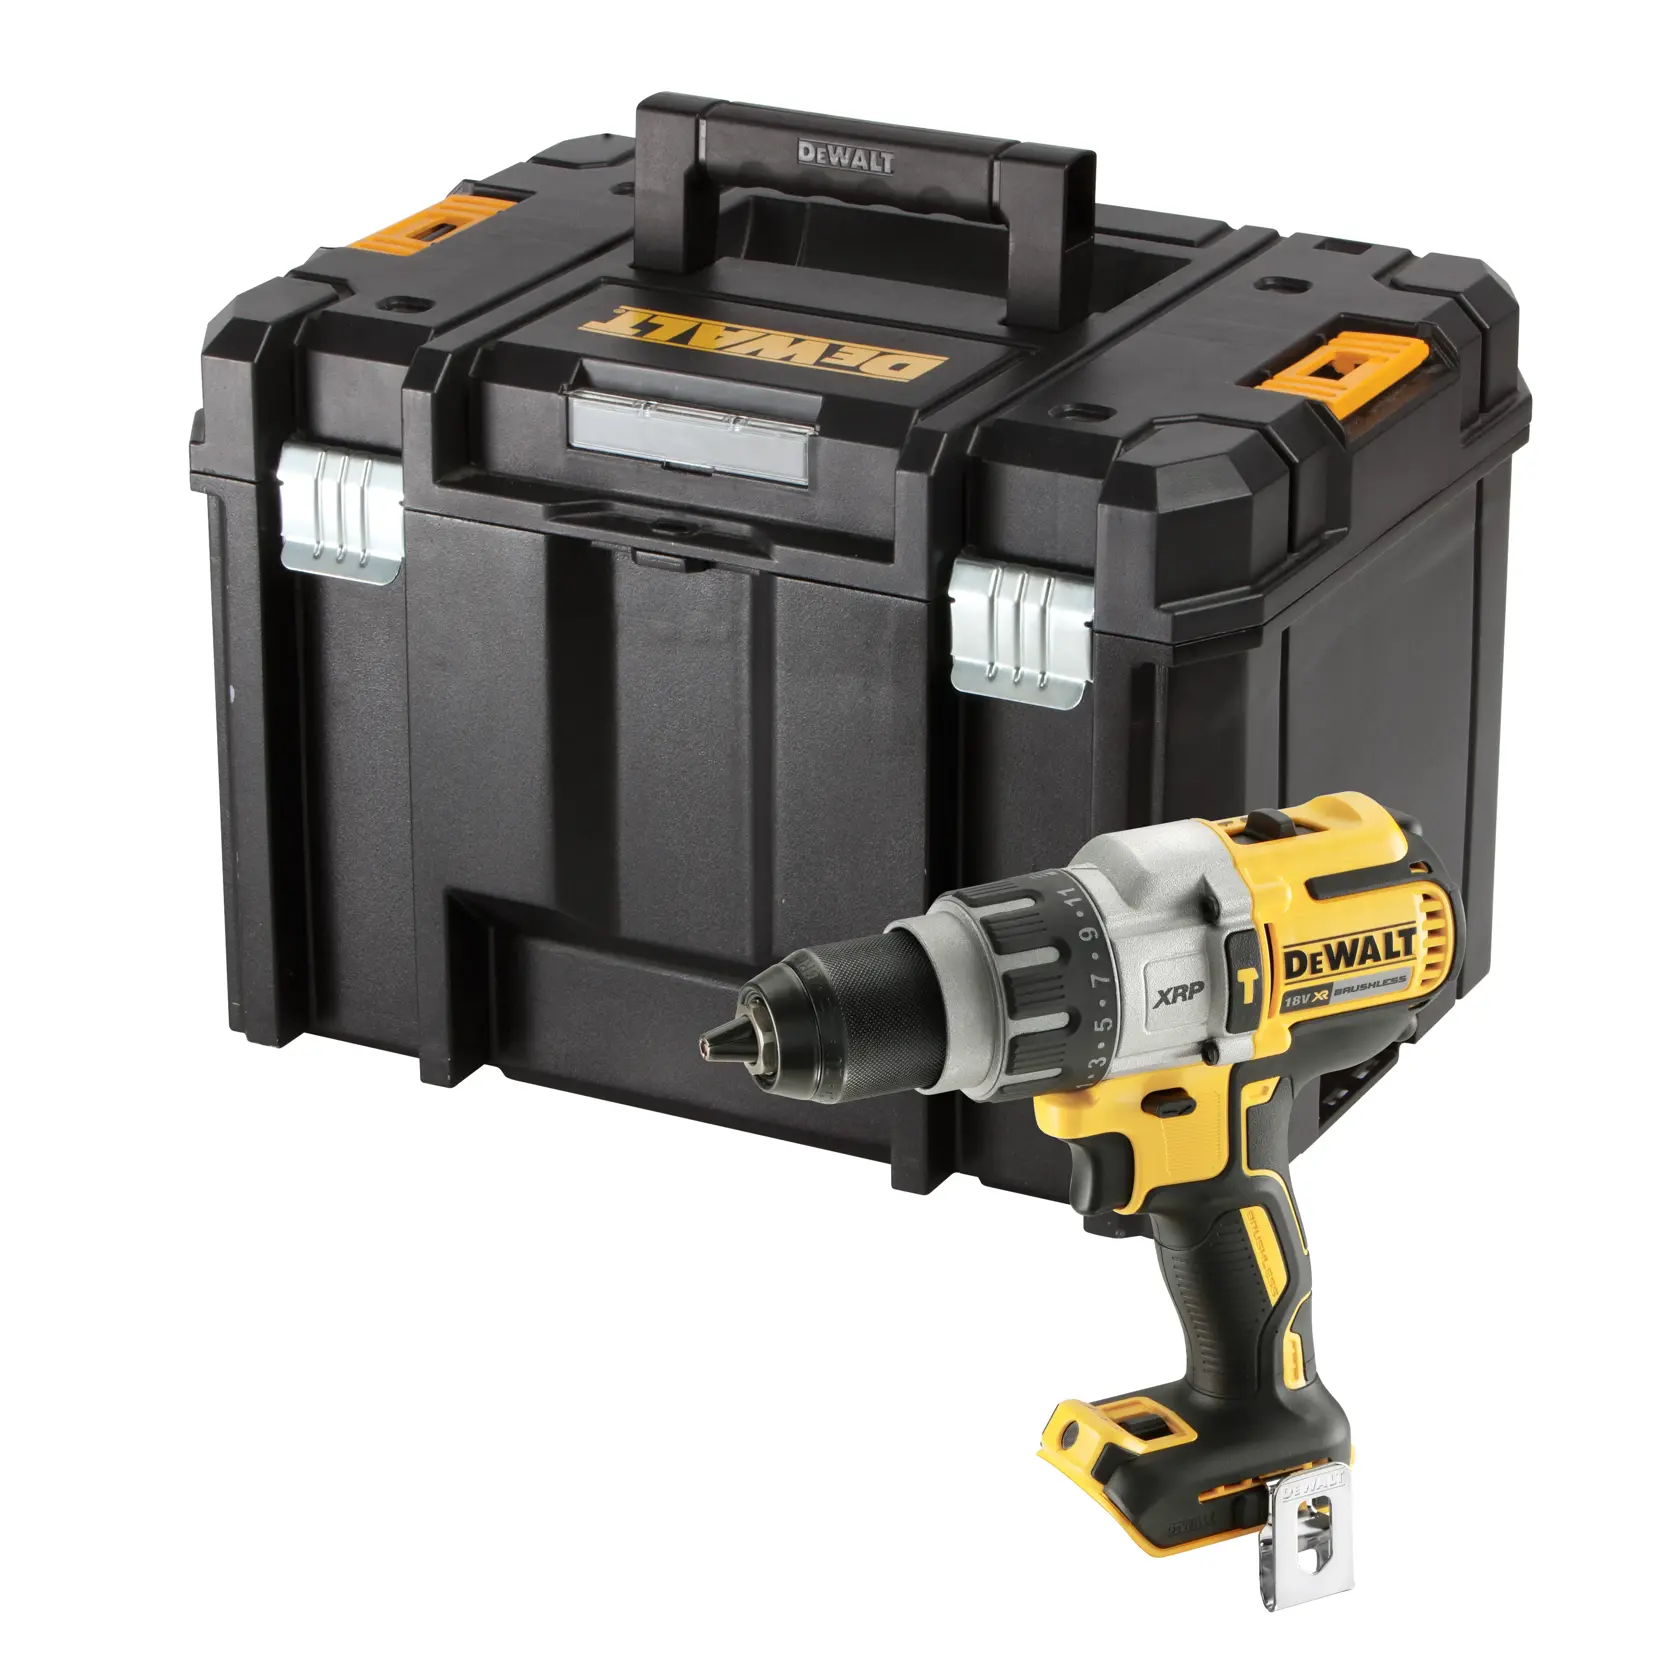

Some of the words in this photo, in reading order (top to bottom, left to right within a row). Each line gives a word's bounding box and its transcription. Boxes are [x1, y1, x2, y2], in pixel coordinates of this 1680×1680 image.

[1056, 887, 1082, 907] 11
[1079, 927, 1099, 942] 9
[1090, 973, 1110, 988] 7
[1152, 980, 1205, 1010] XRP
[1284, 993, 1311, 1008] 18V
[1311, 989, 1329, 1003] XR
[1333, 974, 1407, 997] BRUSHLESS
[1094, 1017, 1113, 1032] 5
[1088, 1056, 1107, 1068] 3
[1247, 1209, 1279, 1298] BRUSHLESS
